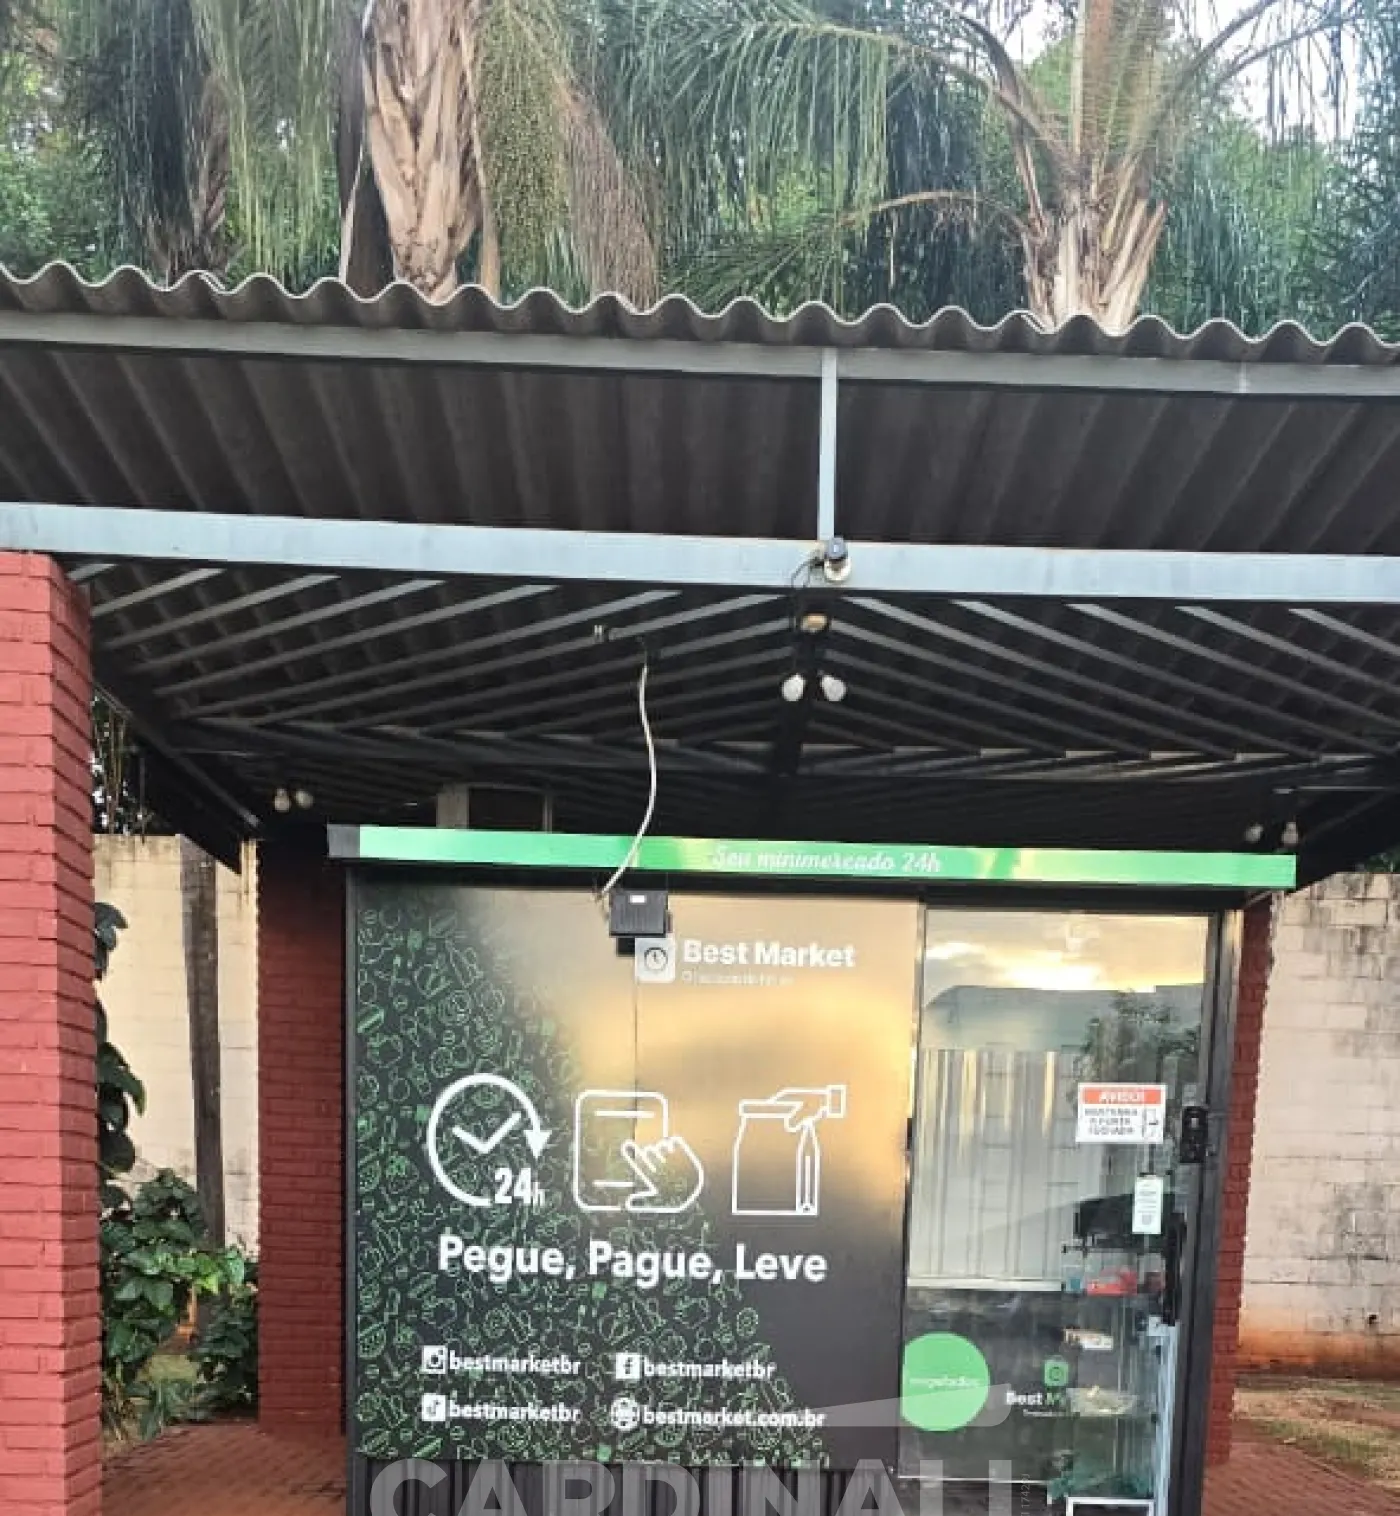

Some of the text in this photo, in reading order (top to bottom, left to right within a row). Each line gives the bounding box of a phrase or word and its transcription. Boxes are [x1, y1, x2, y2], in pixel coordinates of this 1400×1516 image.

[712, 845, 942, 873] Seu minimercado 24h
[683, 939, 857, 968] Best Market
[494, 1167, 546, 1207] 24h
[438, 1233, 829, 1289] Pegue, Pague, Leve
[449, 1349, 582, 1375] bestmarketbr
[643, 1357, 777, 1380] bestmarketbr
[449, 1400, 582, 1424] bestmarketbr
[643, 1404, 828, 1428] bestmarket.com.br
